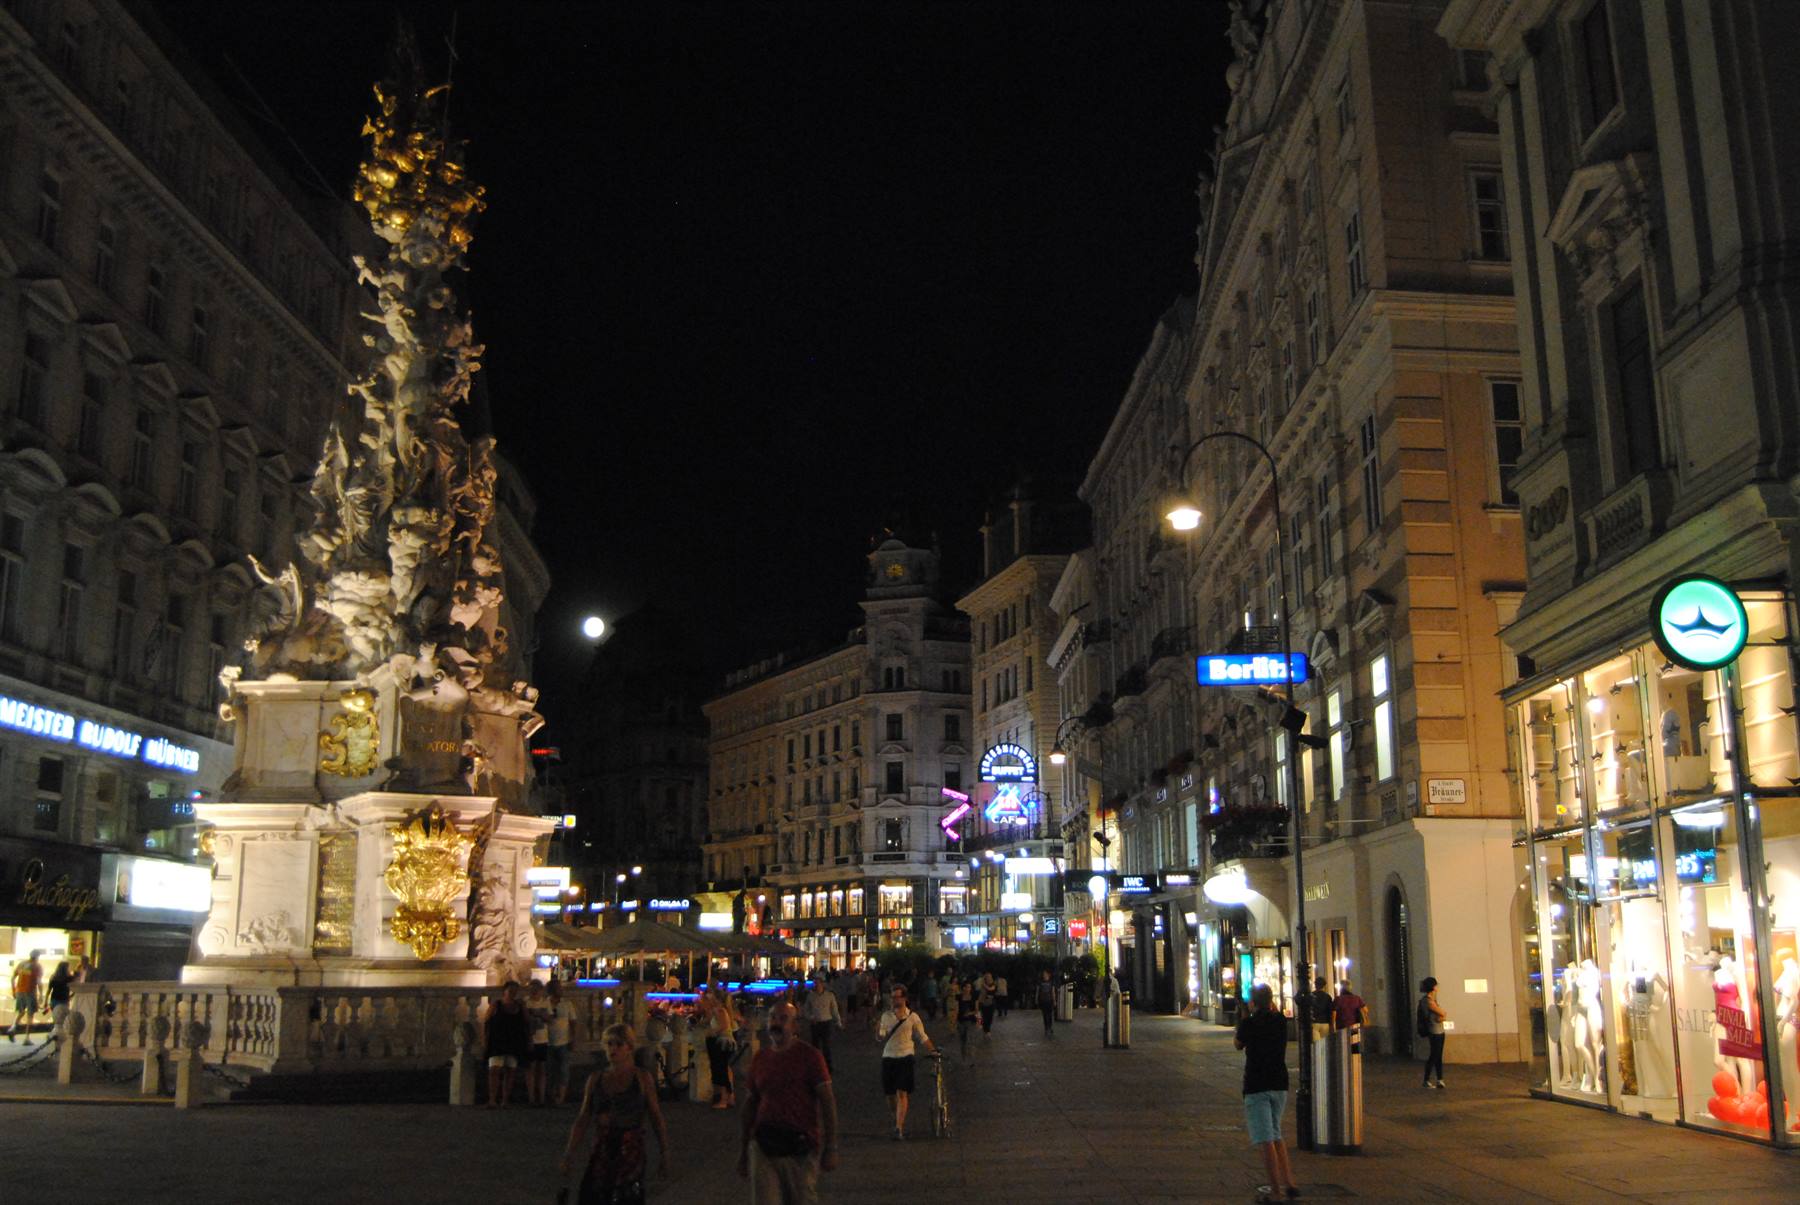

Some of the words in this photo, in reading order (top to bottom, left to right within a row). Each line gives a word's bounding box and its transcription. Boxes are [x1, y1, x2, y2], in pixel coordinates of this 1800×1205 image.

[1209, 656, 1294, 680] Berlitz
[0, 697, 75, 740] MEISTER
[79, 720, 142, 757] RUDOLF
[146, 737, 200, 772] HÜBNER
[1123, 876, 1143, 887] IWC
[1717, 1006, 1746, 1029] FINAL
[1727, 1025, 1754, 1048] SALE!
